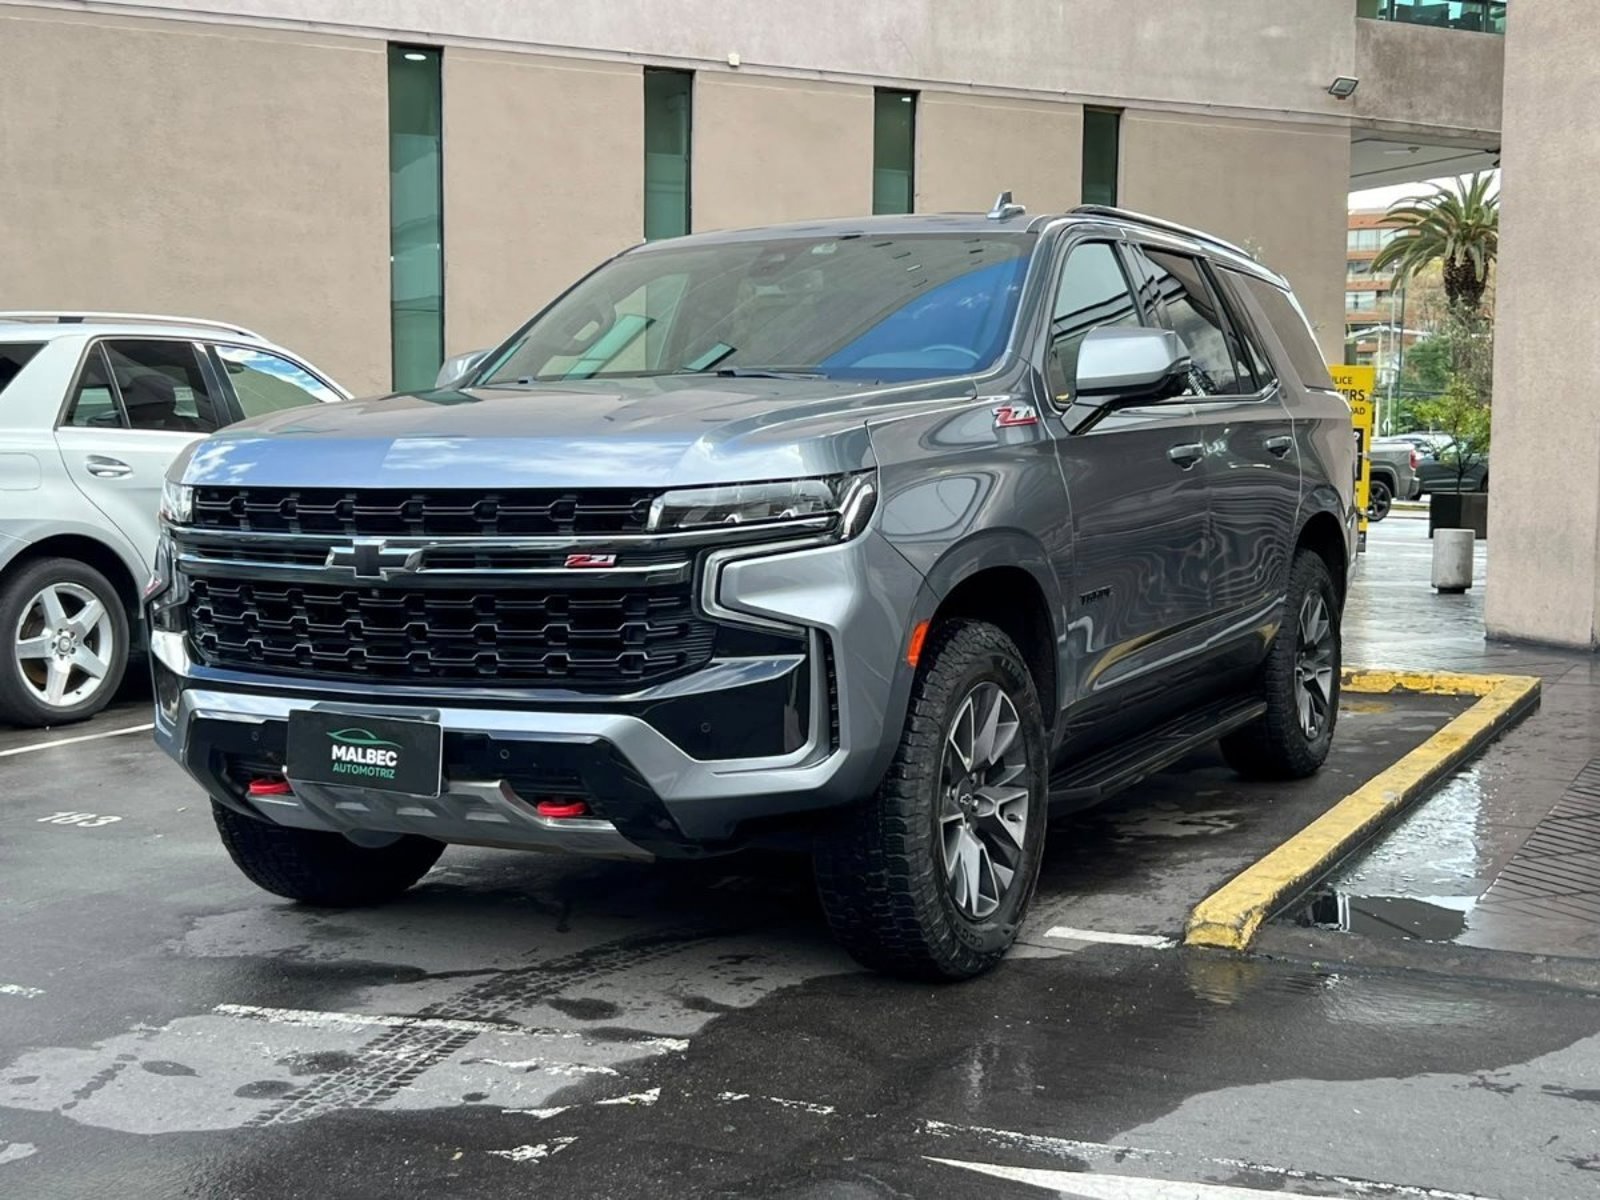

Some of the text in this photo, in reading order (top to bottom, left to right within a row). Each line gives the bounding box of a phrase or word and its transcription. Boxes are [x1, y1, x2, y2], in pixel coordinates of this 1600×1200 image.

[1332, 376, 1353, 385] LICE
[1351, 406, 1366, 415] AD
[331, 744, 398, 767] MALBEC
[332, 762, 396, 779] AUTOMOTRIZ
[36, 811, 123, 828] 183
